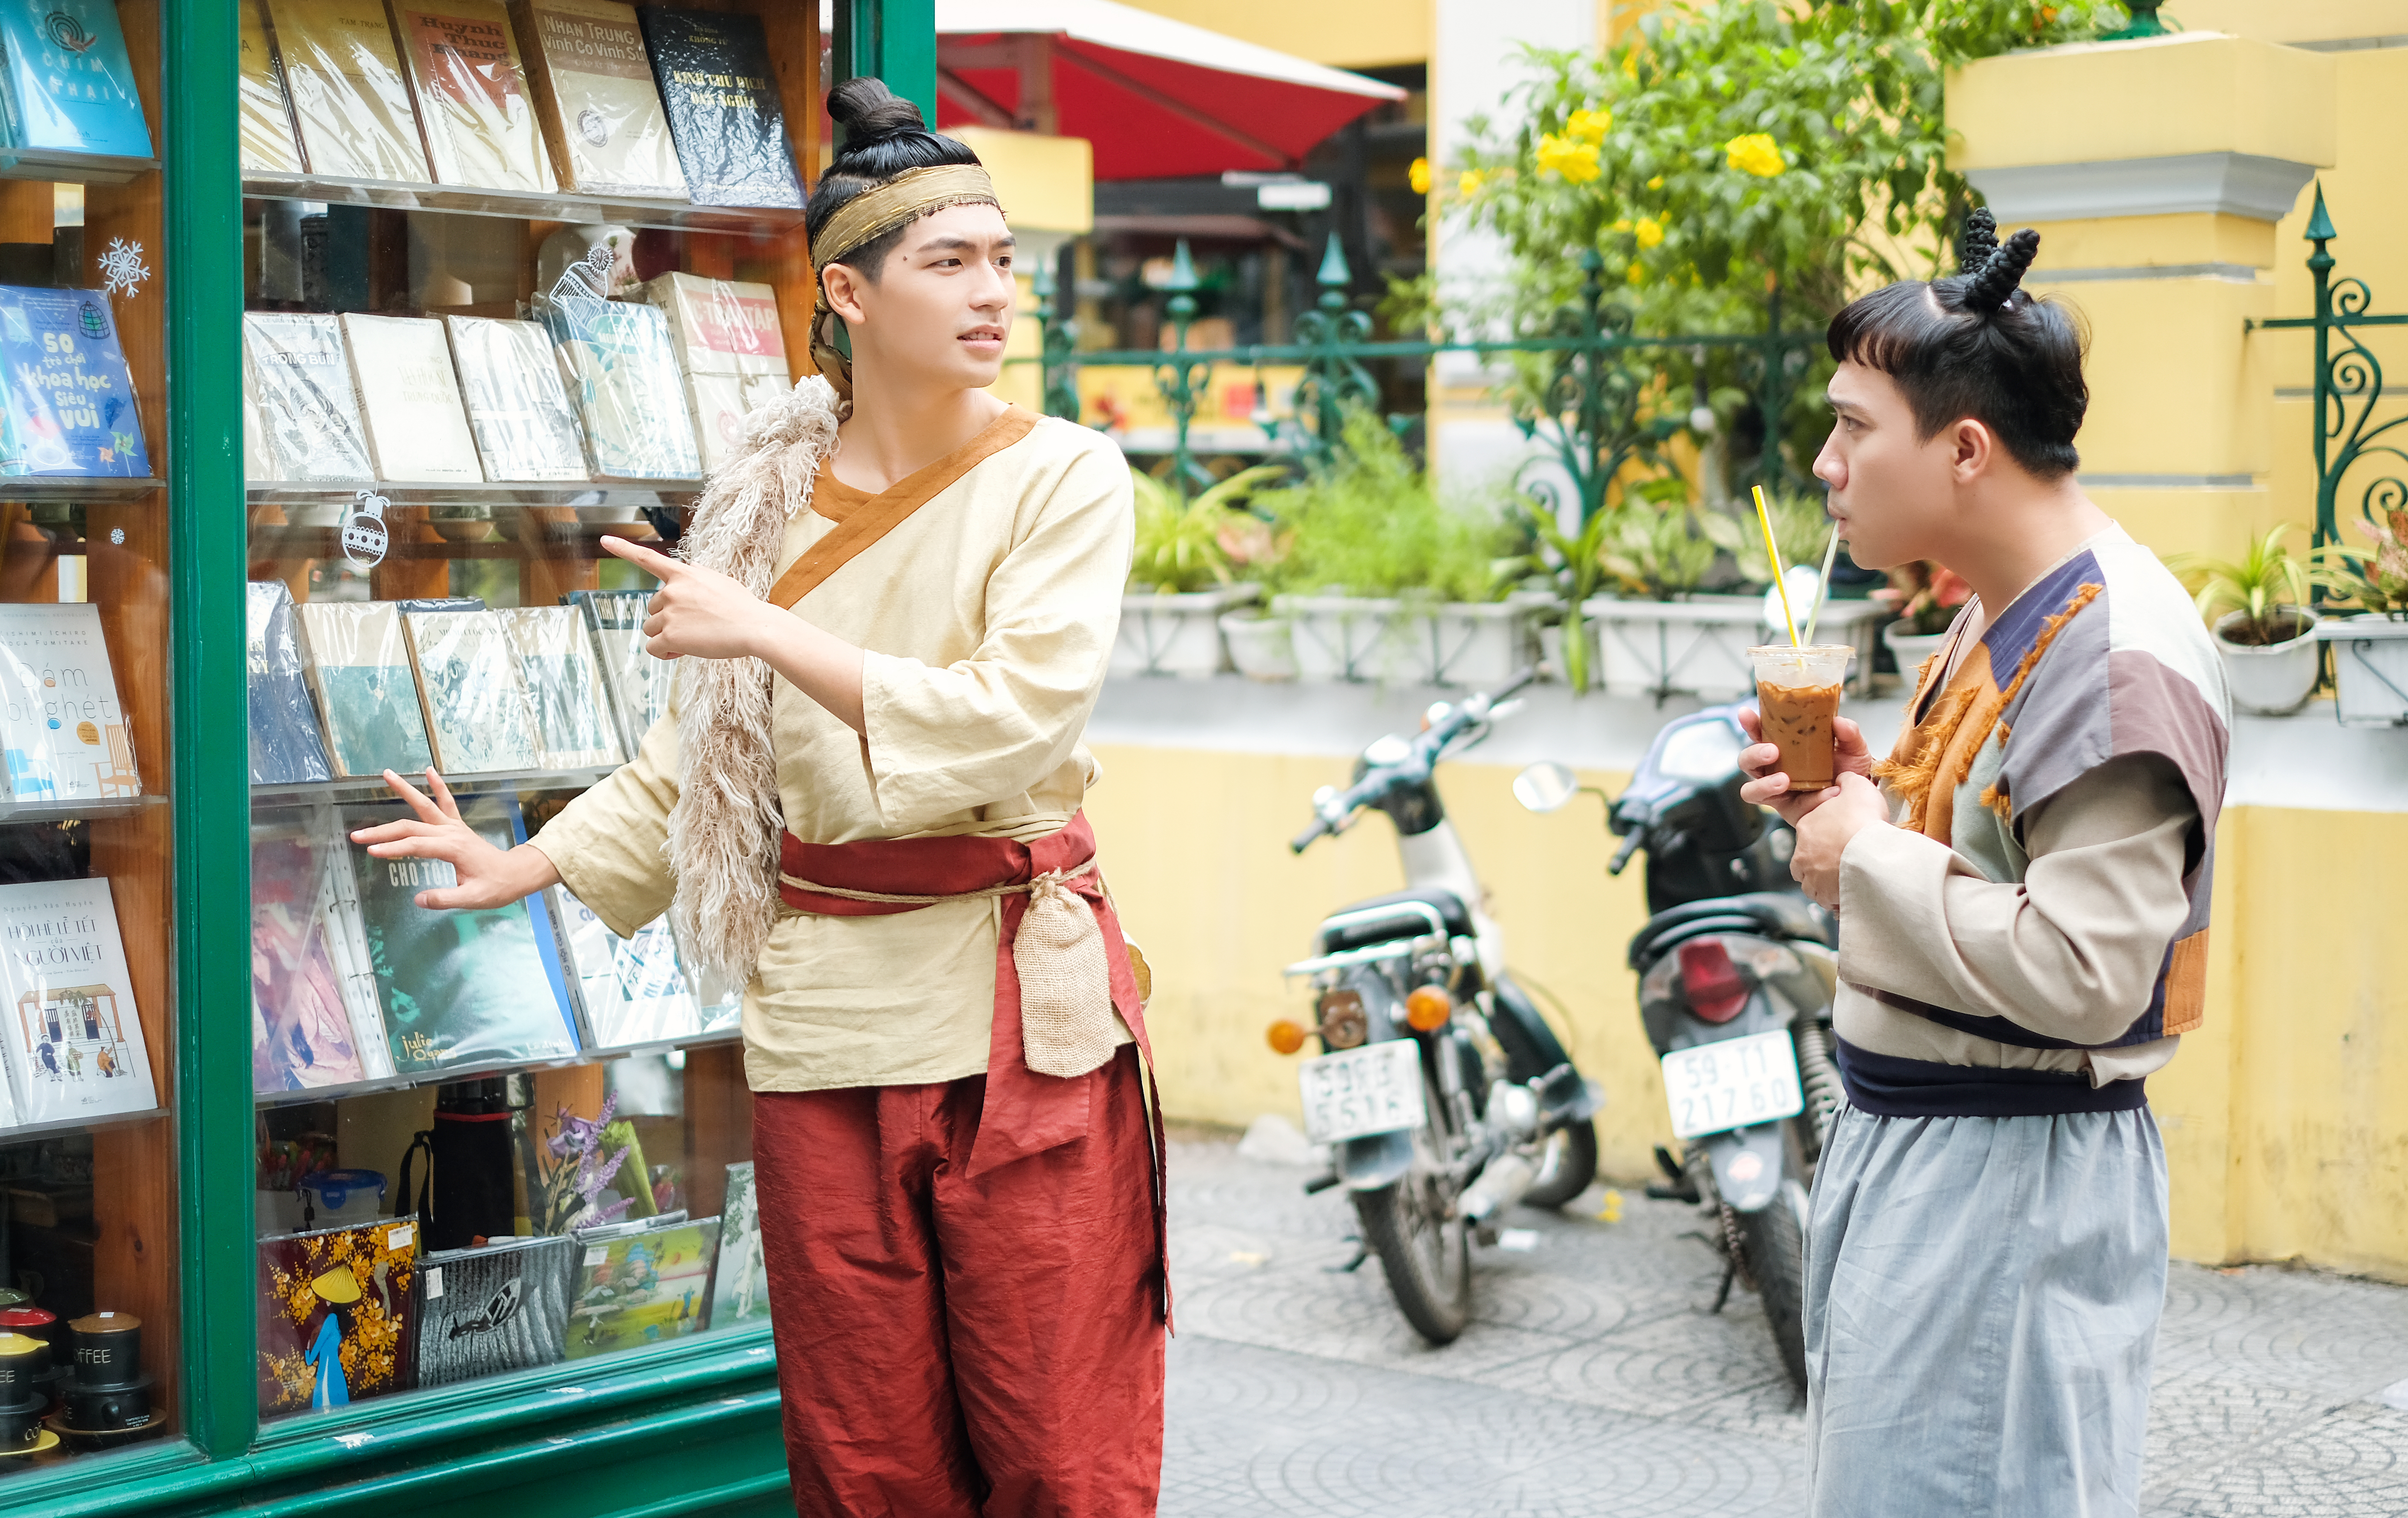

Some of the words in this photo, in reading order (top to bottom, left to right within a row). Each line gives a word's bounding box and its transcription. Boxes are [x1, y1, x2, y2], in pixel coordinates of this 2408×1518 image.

[23, 362, 74, 390] khoa
[74, 366, 112, 393] học
[17, 662, 88, 688] Dám
[45, 693, 112, 730] ghét
[388, 862, 419, 887] CHO
[8, 922, 35, 941] HỘI
[37, 919, 56, 936] HÈ
[57, 916, 72, 935] LỄ
[73, 914, 96, 933] TẾT
[13, 944, 69, 968] NGƯỜI
[70, 942, 102, 964] VIỆT
